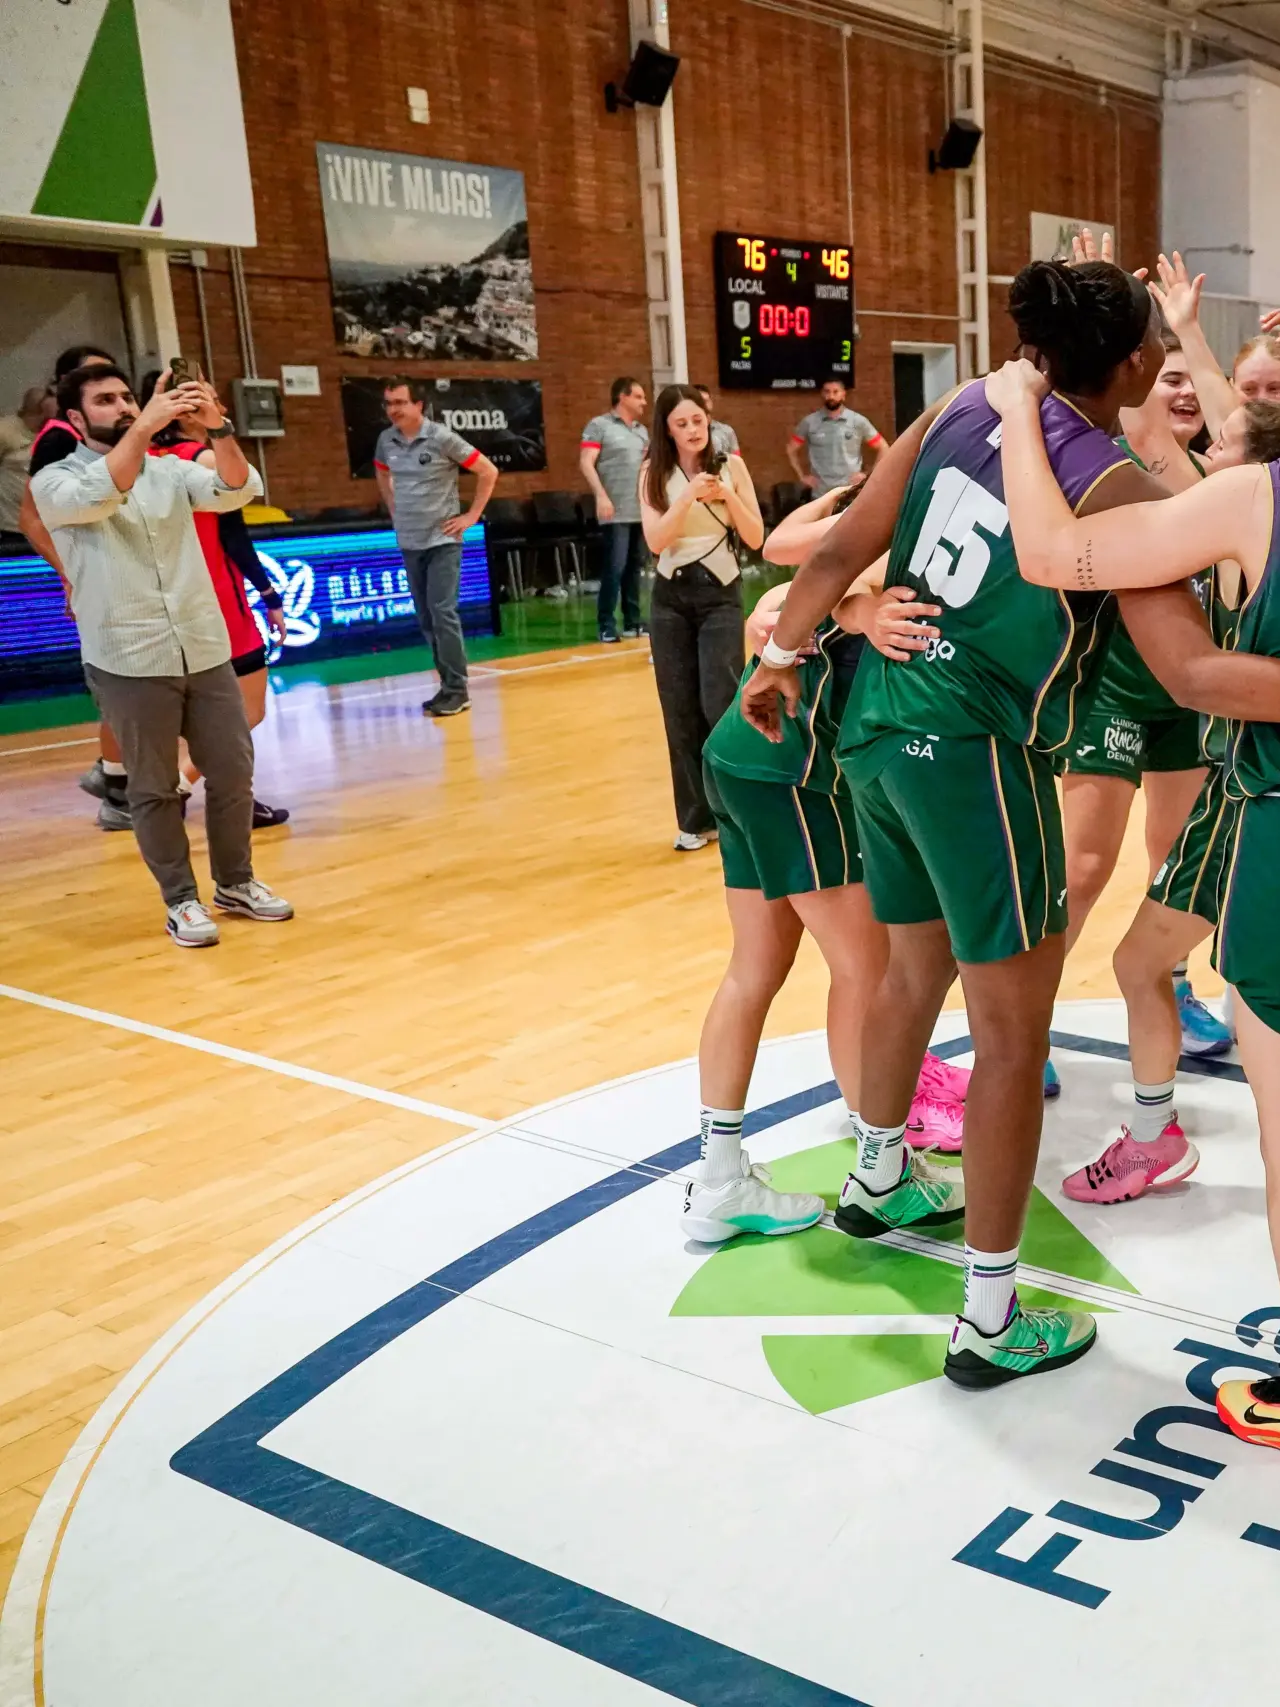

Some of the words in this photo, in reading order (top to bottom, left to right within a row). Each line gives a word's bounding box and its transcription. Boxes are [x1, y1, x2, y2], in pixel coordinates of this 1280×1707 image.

[401, 163, 493, 220] MIJAS!
[737, 238, 766, 272] 76
[822, 248, 850, 279] 46
[728, 276, 766, 295] LOCAL
[786, 262, 797, 282] 4
[759, 303, 810, 337] 00:0
[741, 336, 752, 358] 5
[841, 340, 851, 361] 3
[908, 466, 1009, 608] 15
